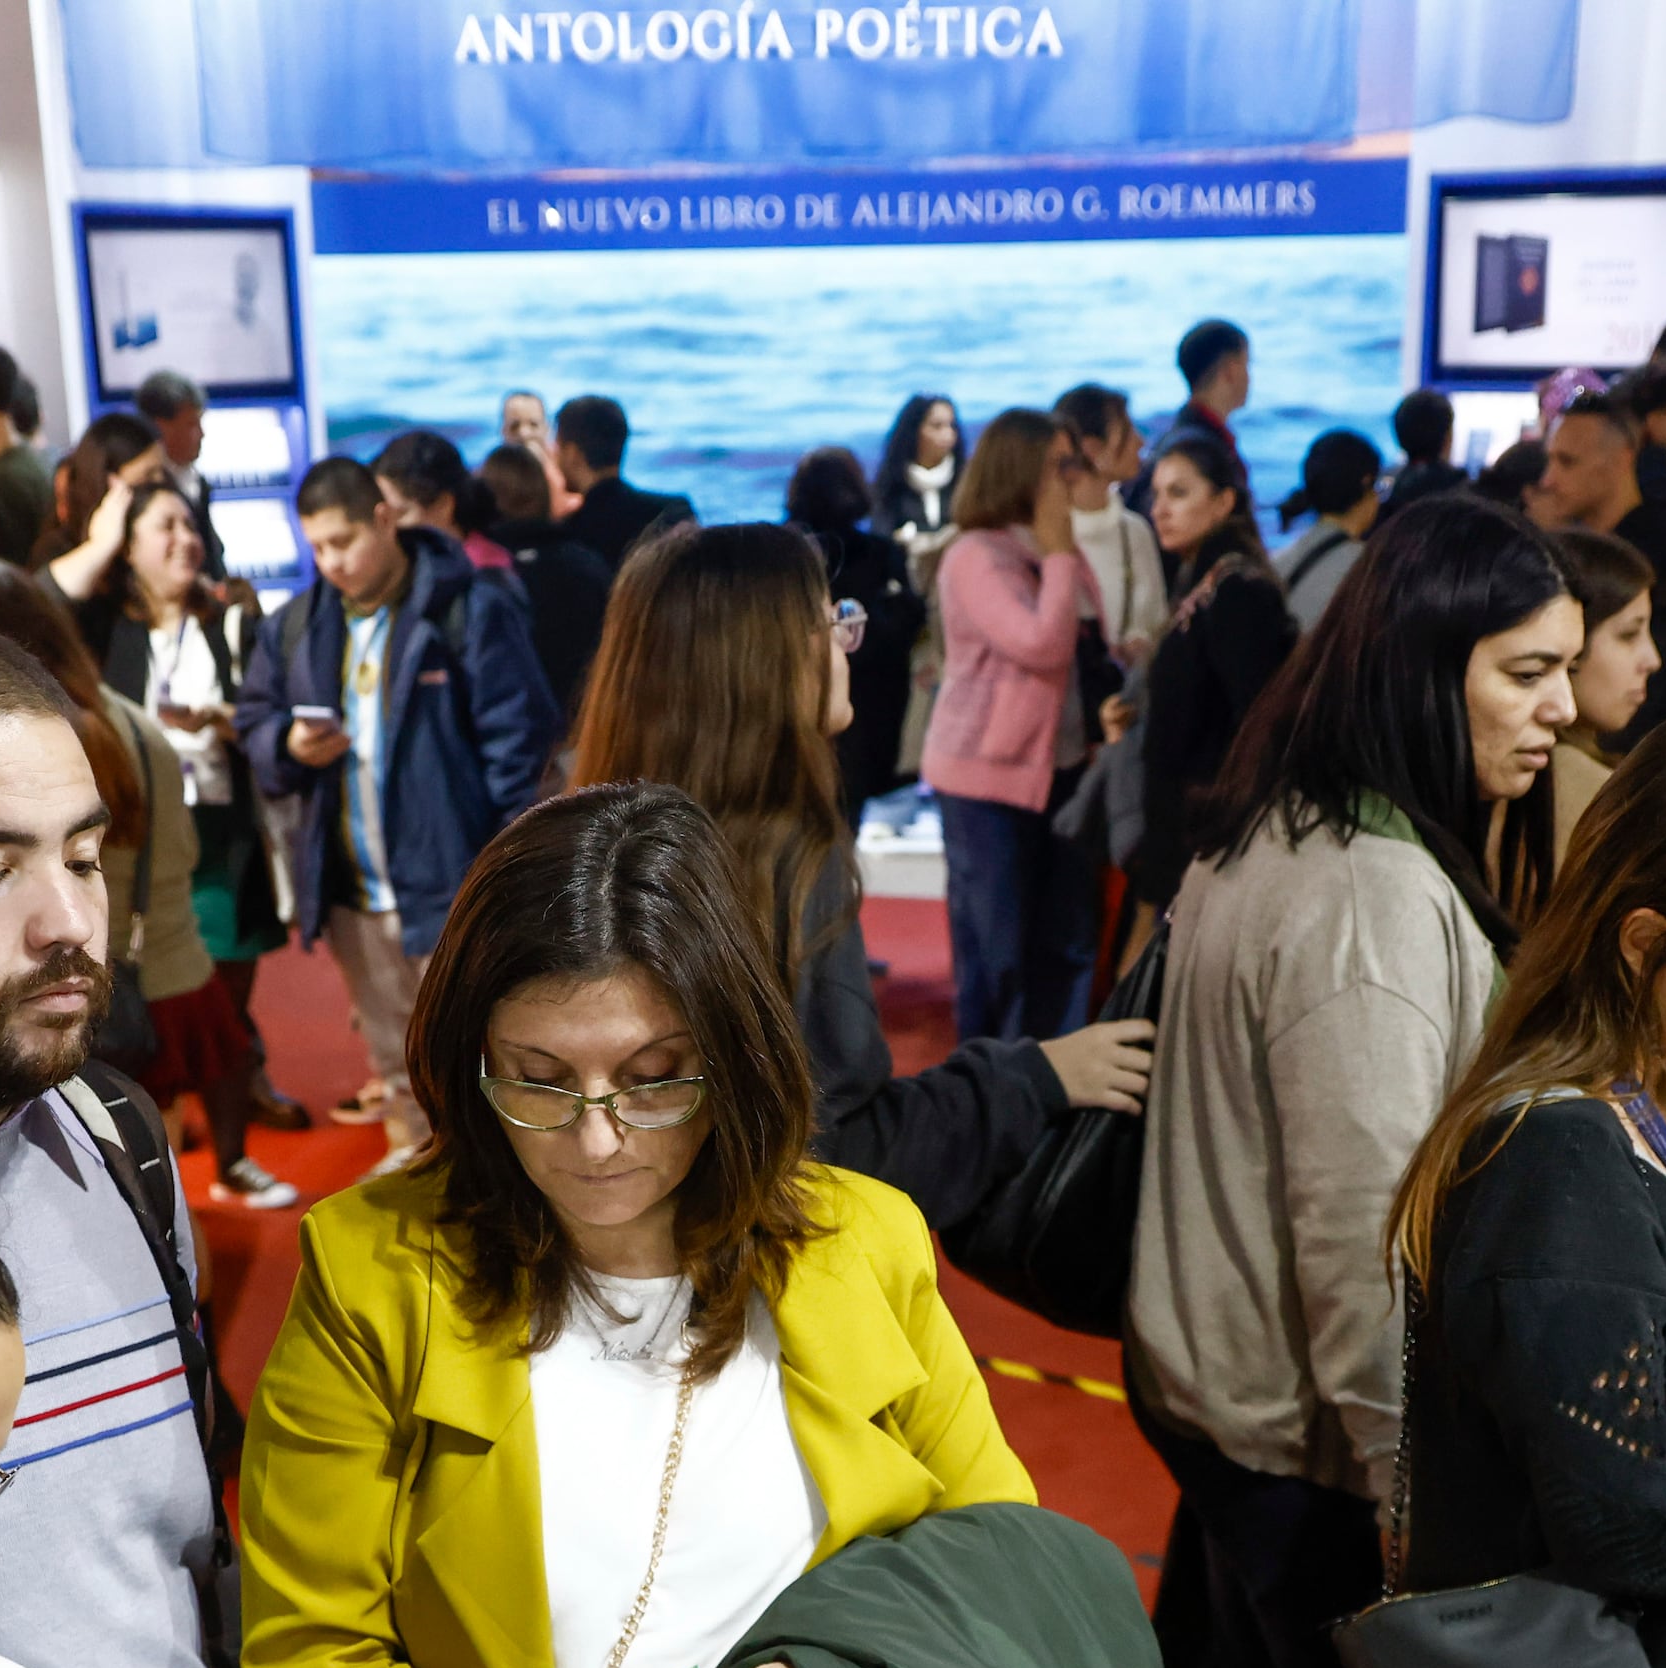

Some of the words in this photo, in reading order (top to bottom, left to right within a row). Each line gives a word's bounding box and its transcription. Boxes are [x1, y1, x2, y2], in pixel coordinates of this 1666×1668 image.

[454, 0, 793, 63] ANTOLOGÍA
[814, 0, 1064, 60] POÉTICA
[487, 199, 528, 234] EL
[540, 196, 671, 232] NUEVO
[679, 193, 786, 230] LIBRO
[795, 192, 841, 228] DE
[852, 186, 1064, 233] ALEJANDRO
[1071, 185, 1109, 220] G.
[1118, 180, 1316, 220] ROEMMERS
